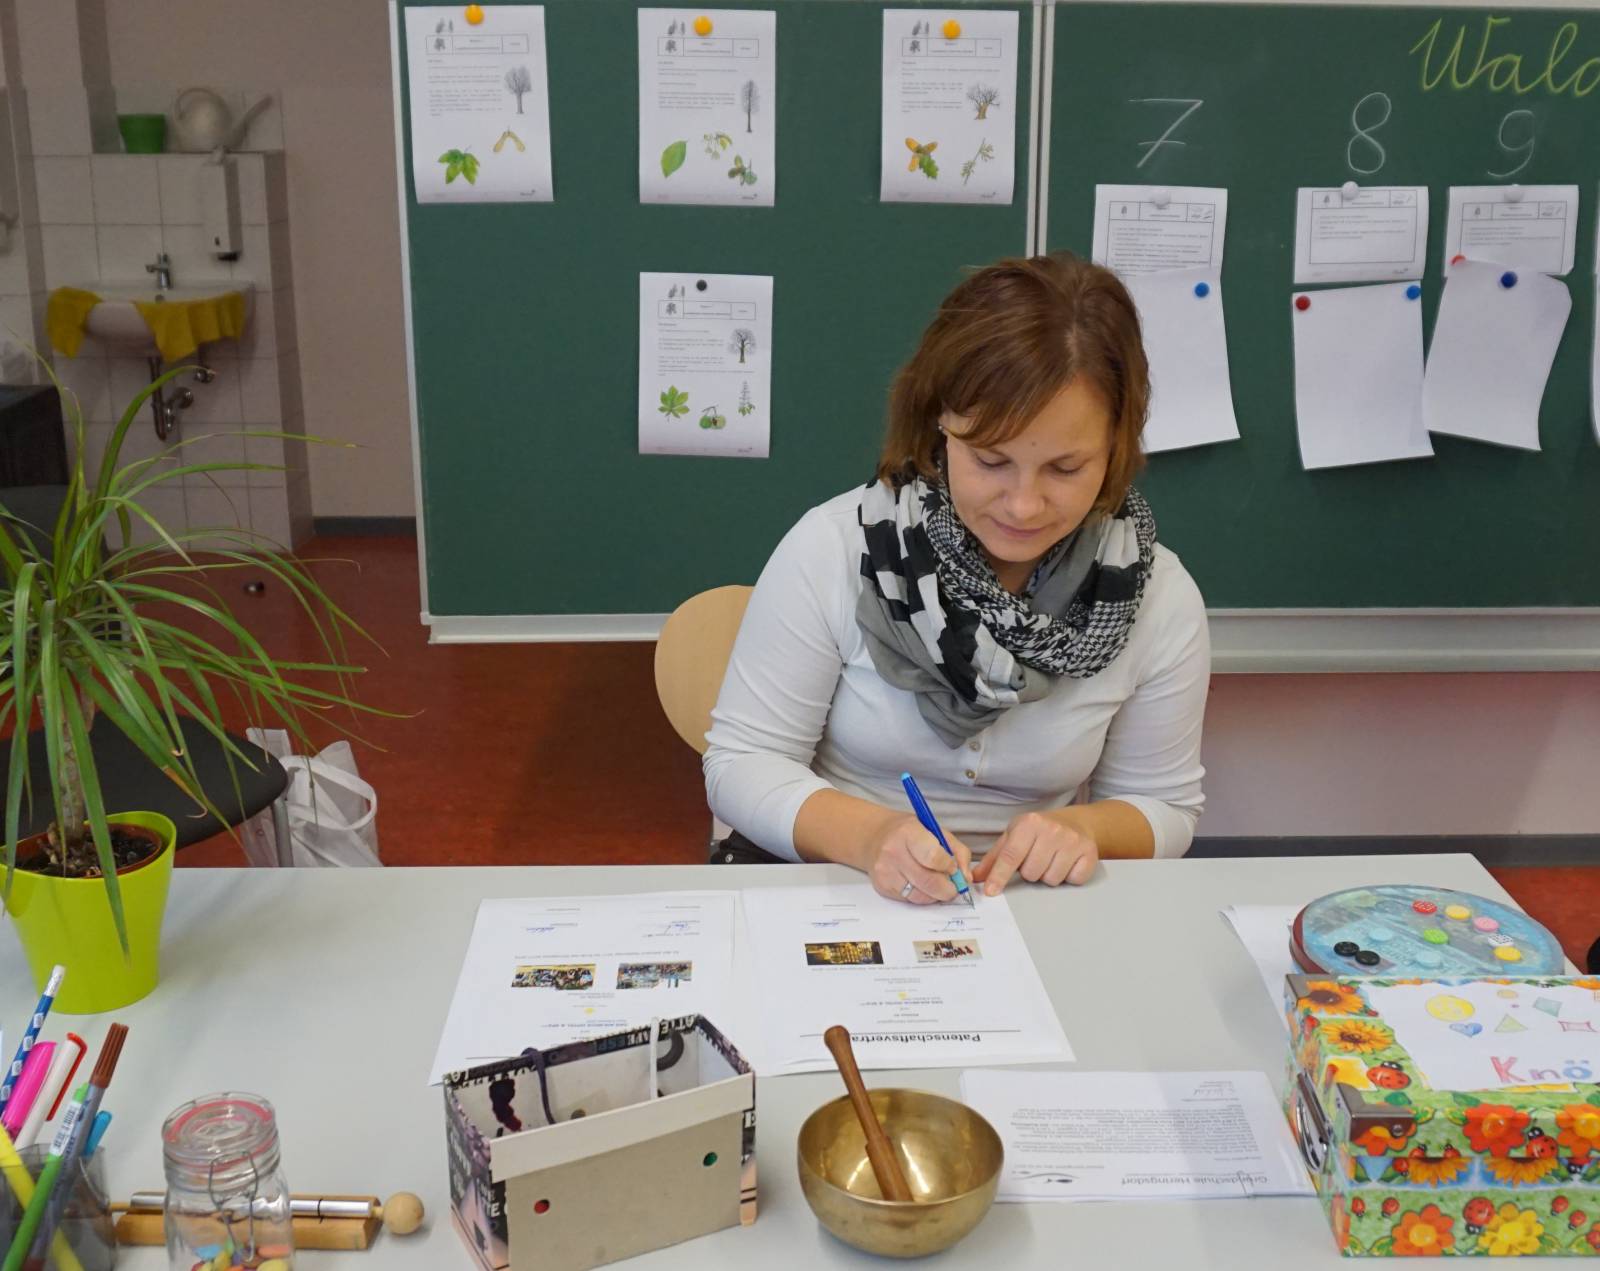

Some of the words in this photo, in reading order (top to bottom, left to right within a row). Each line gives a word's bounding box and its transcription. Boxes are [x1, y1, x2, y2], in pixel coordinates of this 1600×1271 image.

[1128, 97, 1204, 169] 7
[1348, 91, 1393, 175] 8
[1487, 108, 1536, 178] 9
[850, 1032, 982, 1044] Patenschaftsvertra
[1121, 1175, 1192, 1186] Heringsdorf
